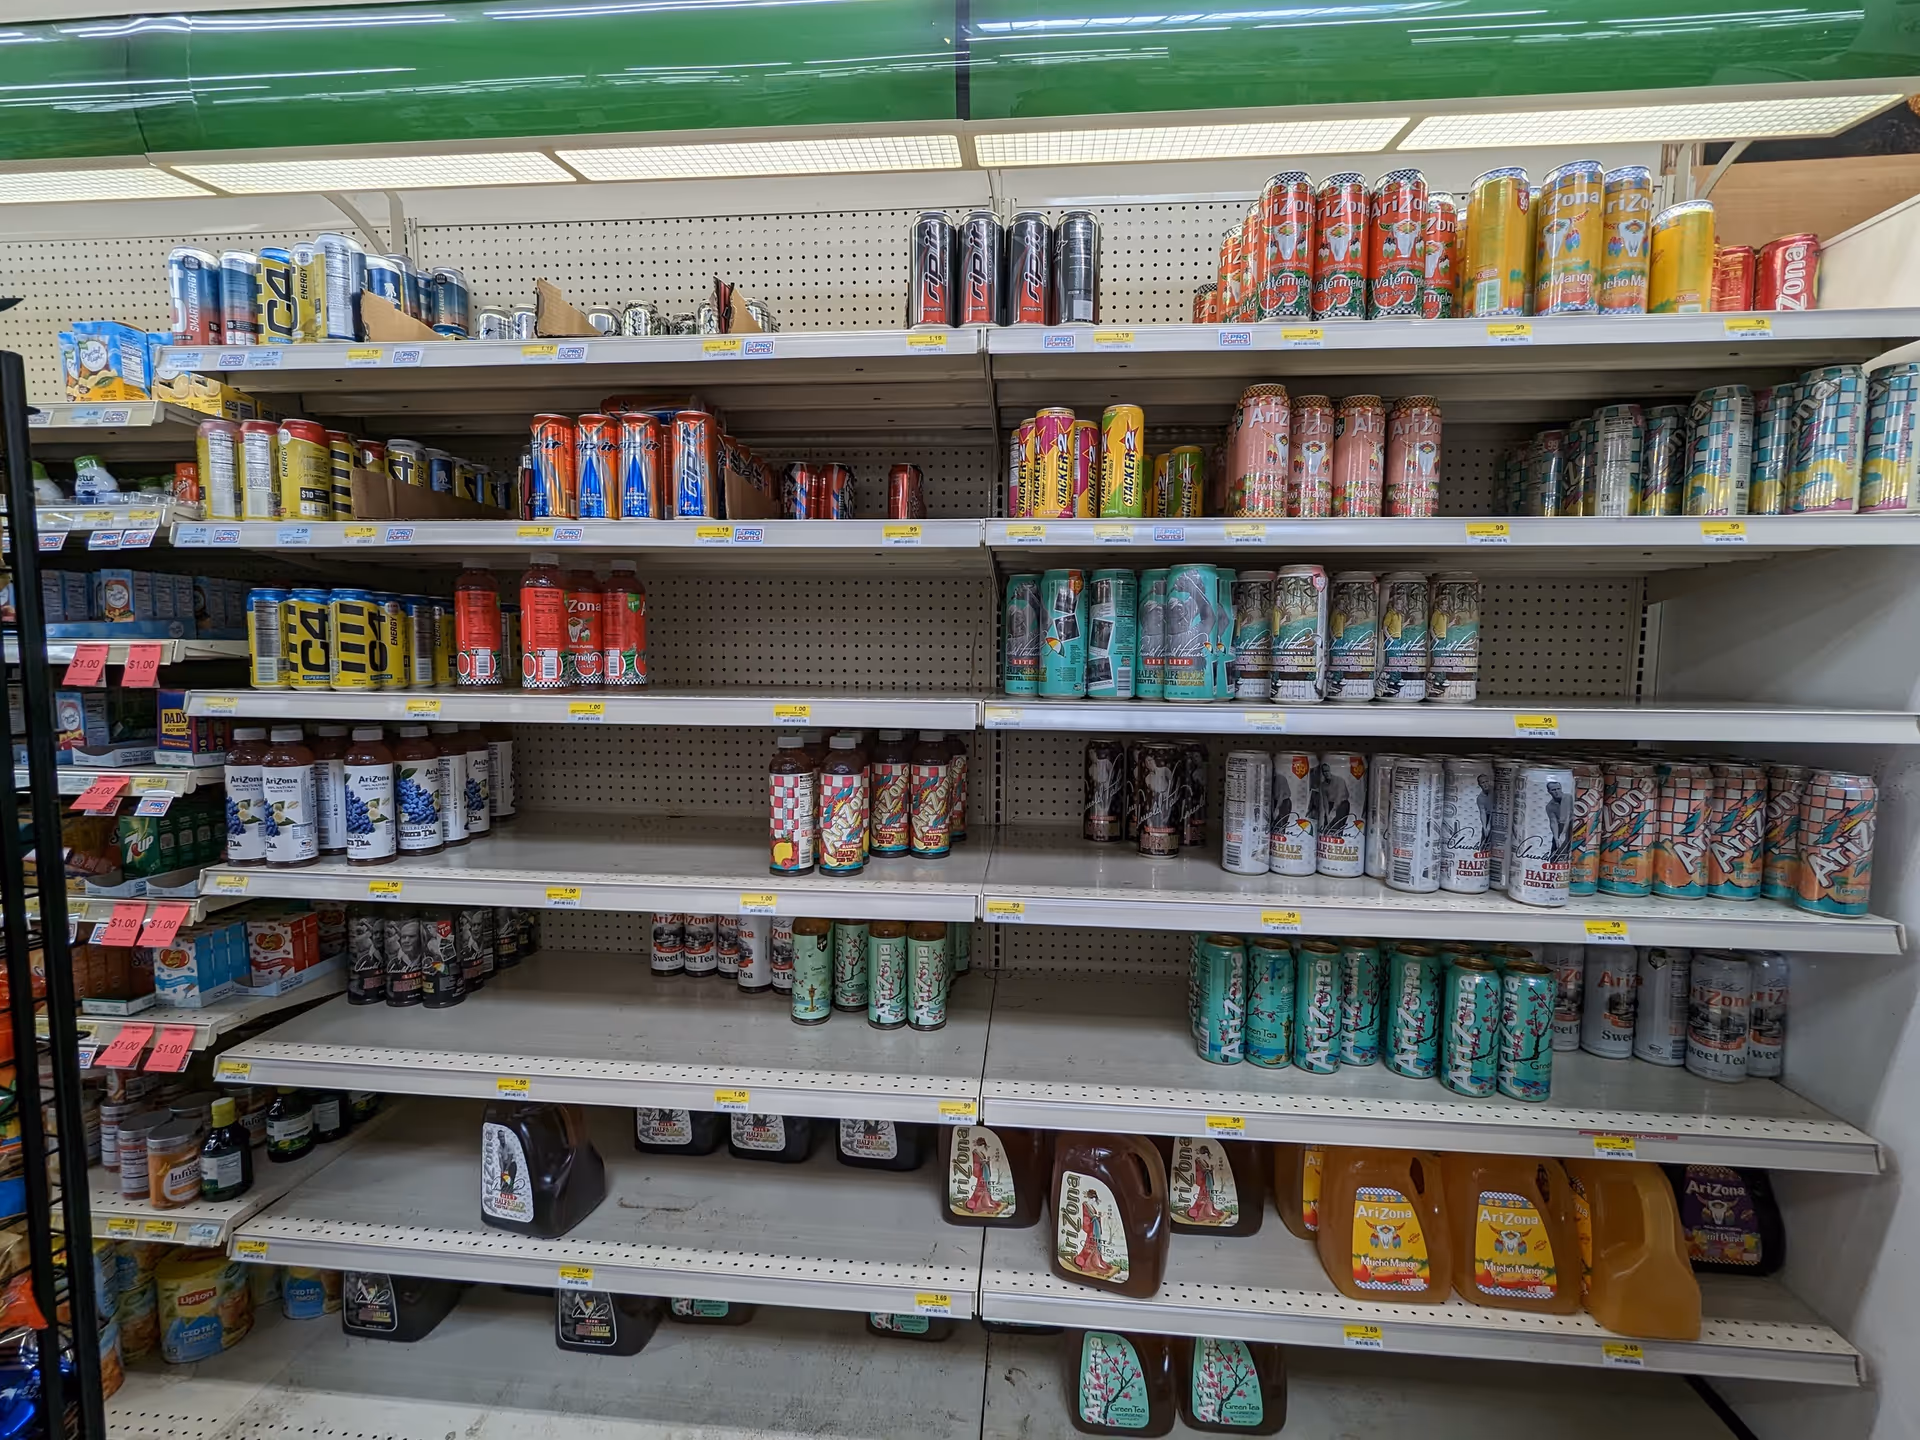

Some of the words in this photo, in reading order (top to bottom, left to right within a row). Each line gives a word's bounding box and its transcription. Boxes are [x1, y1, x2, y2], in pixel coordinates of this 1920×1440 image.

[300, 266, 308, 300] ENERGY
[1552, 271, 1593, 286] Mango
[1124, 430, 1135, 451] 2
[1057, 452, 1069, 508] STACKER
[1123, 450, 1136, 506] STACKER
[1019, 462, 1028, 513] STACKER
[1088, 462, 1097, 515] STACKER
[301, 490, 314, 499] $10
[1392, 489, 1411, 501] Kiwi
[390, 616, 398, 646] ENERGY
[299, 608, 329, 672] C4
[72, 659, 100, 669] $1.00
[128, 660, 155, 670] $1.00
[265, 776, 298, 785] AriZona
[358, 775, 390, 784] AriZona
[85, 786, 115, 795] $1.00
[1523, 880, 1541, 888] ICED
[1542, 881, 1555, 889] TEA
[110, 918, 137, 928] $1.00
[150, 919, 177, 929] $1.00
[652, 954, 680, 964] Sweet
[698, 955, 715, 963] Tea
[739, 970, 753, 980] Tea
[1261, 1029, 1277, 1039] Tea
[111, 1040, 139, 1051] $1.00
[156, 1043, 183, 1054] $1.00
[1725, 1053, 1745, 1066] Tea
[1685, 1180, 1746, 1197] AriZona
[1355, 1204, 1412, 1221] AriZona
[1479, 1208, 1539, 1226] AriZona
[1060, 1173, 1081, 1272] AriZona
[1101, 1246, 1115, 1255] Tea
[1360, 1256, 1389, 1268] Mucho
[1390, 1259, 1418, 1270] Mango
[1484, 1260, 1515, 1273] Mucho
[1515, 1265, 1545, 1277] Mango
[180, 1290, 215, 1305] Lipton
[180, 1328, 200, 1339] ICED
[201, 1322, 218, 1333] TEA
[1364, 1326, 1378, 1334] 3.69
[184, 1332, 215, 1344] LEMON
[1624, 1343, 1639, 1351] 3.69
[1110, 1404, 1132, 1414] Green
[1133, 1404, 1146, 1414] Tea
[1224, 1402, 1247, 1412] Green
[1247, 1402, 1260, 1411] Tea
